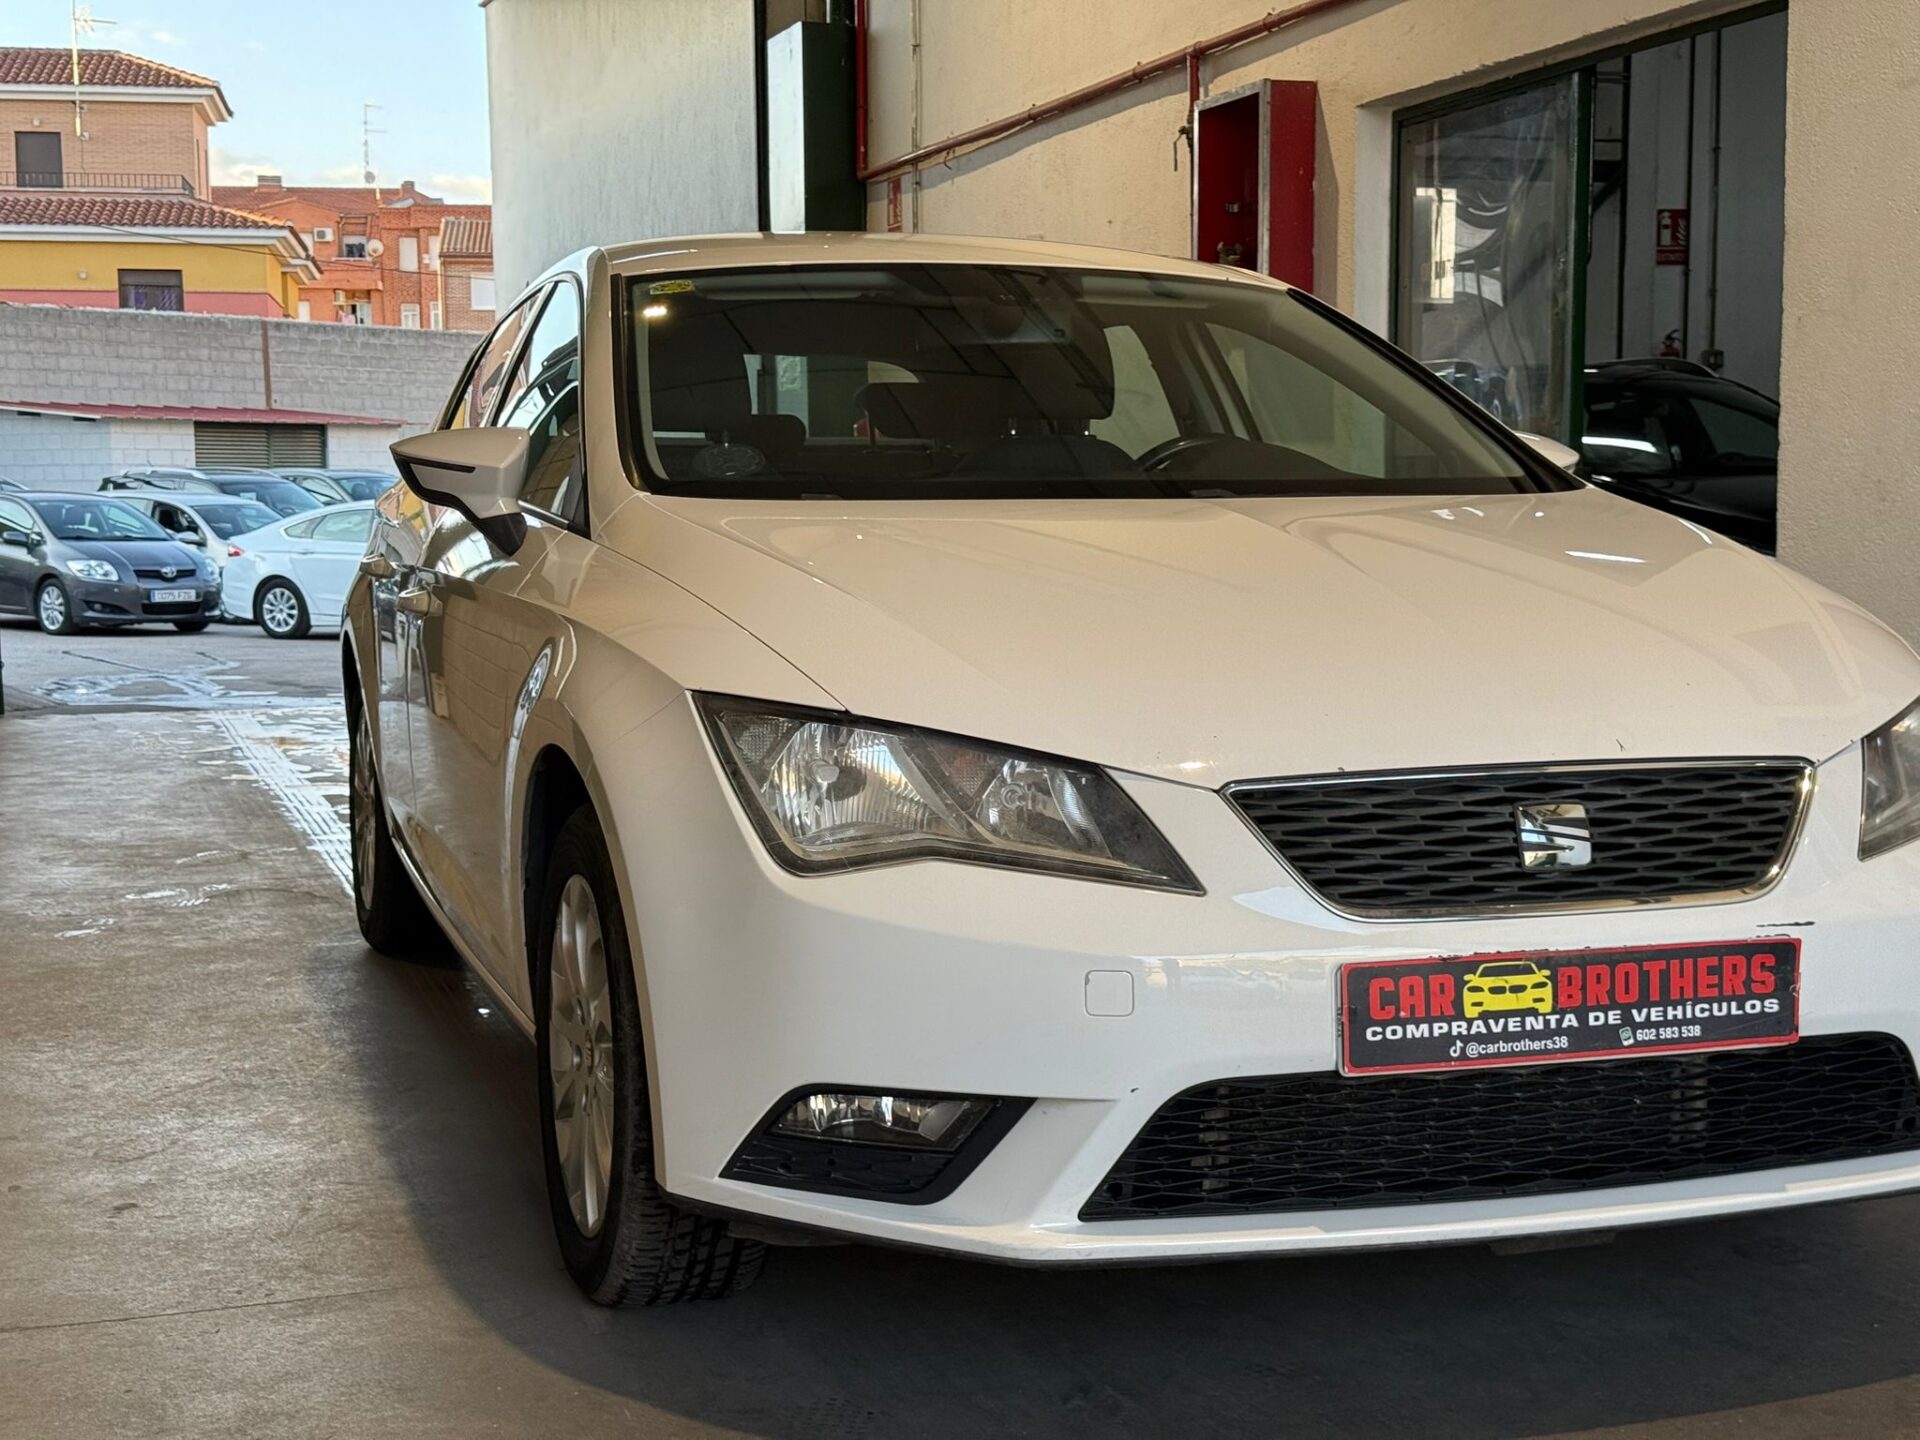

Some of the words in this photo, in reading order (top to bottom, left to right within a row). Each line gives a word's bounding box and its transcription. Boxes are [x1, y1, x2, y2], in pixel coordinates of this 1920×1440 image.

[1369, 974, 1455, 1020] CAR
[1557, 954, 1776, 1009] BROTHERS
[1366, 1014, 1579, 1041] COMPRAVENTA
[1588, 1010, 1622, 1026] DE
[1631, 999, 1780, 1023] VEHÍCULOS
[1636, 1029, 1657, 1040] 602
[1659, 1027, 1679, 1039] 583
[1681, 1025, 1701, 1038] 538
[1465, 1036, 1568, 1058] @carbrothers38
